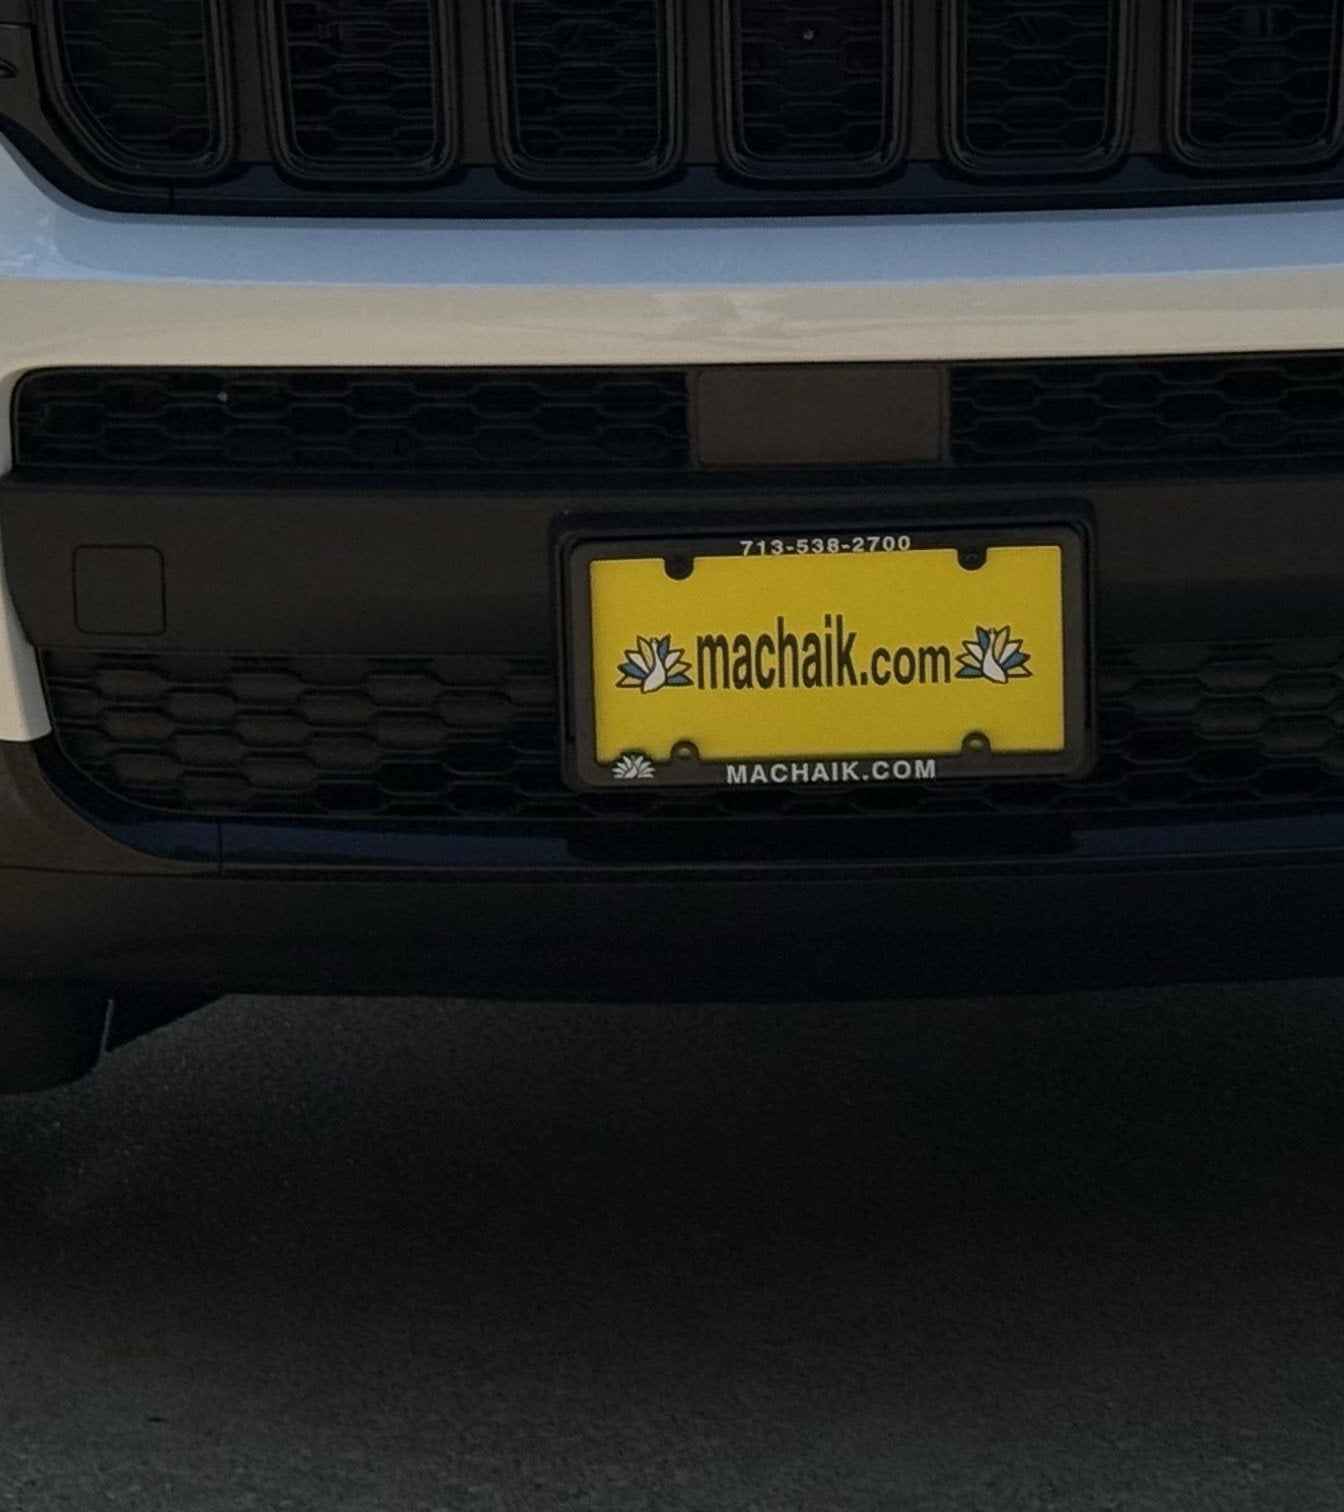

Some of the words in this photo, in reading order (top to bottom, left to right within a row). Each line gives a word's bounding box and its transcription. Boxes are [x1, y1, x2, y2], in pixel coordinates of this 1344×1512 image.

[739, 535, 911, 557] 713-538-2700
[695, 614, 952, 690] machaik.com
[726, 759, 936, 784] MACHAIK.COM
